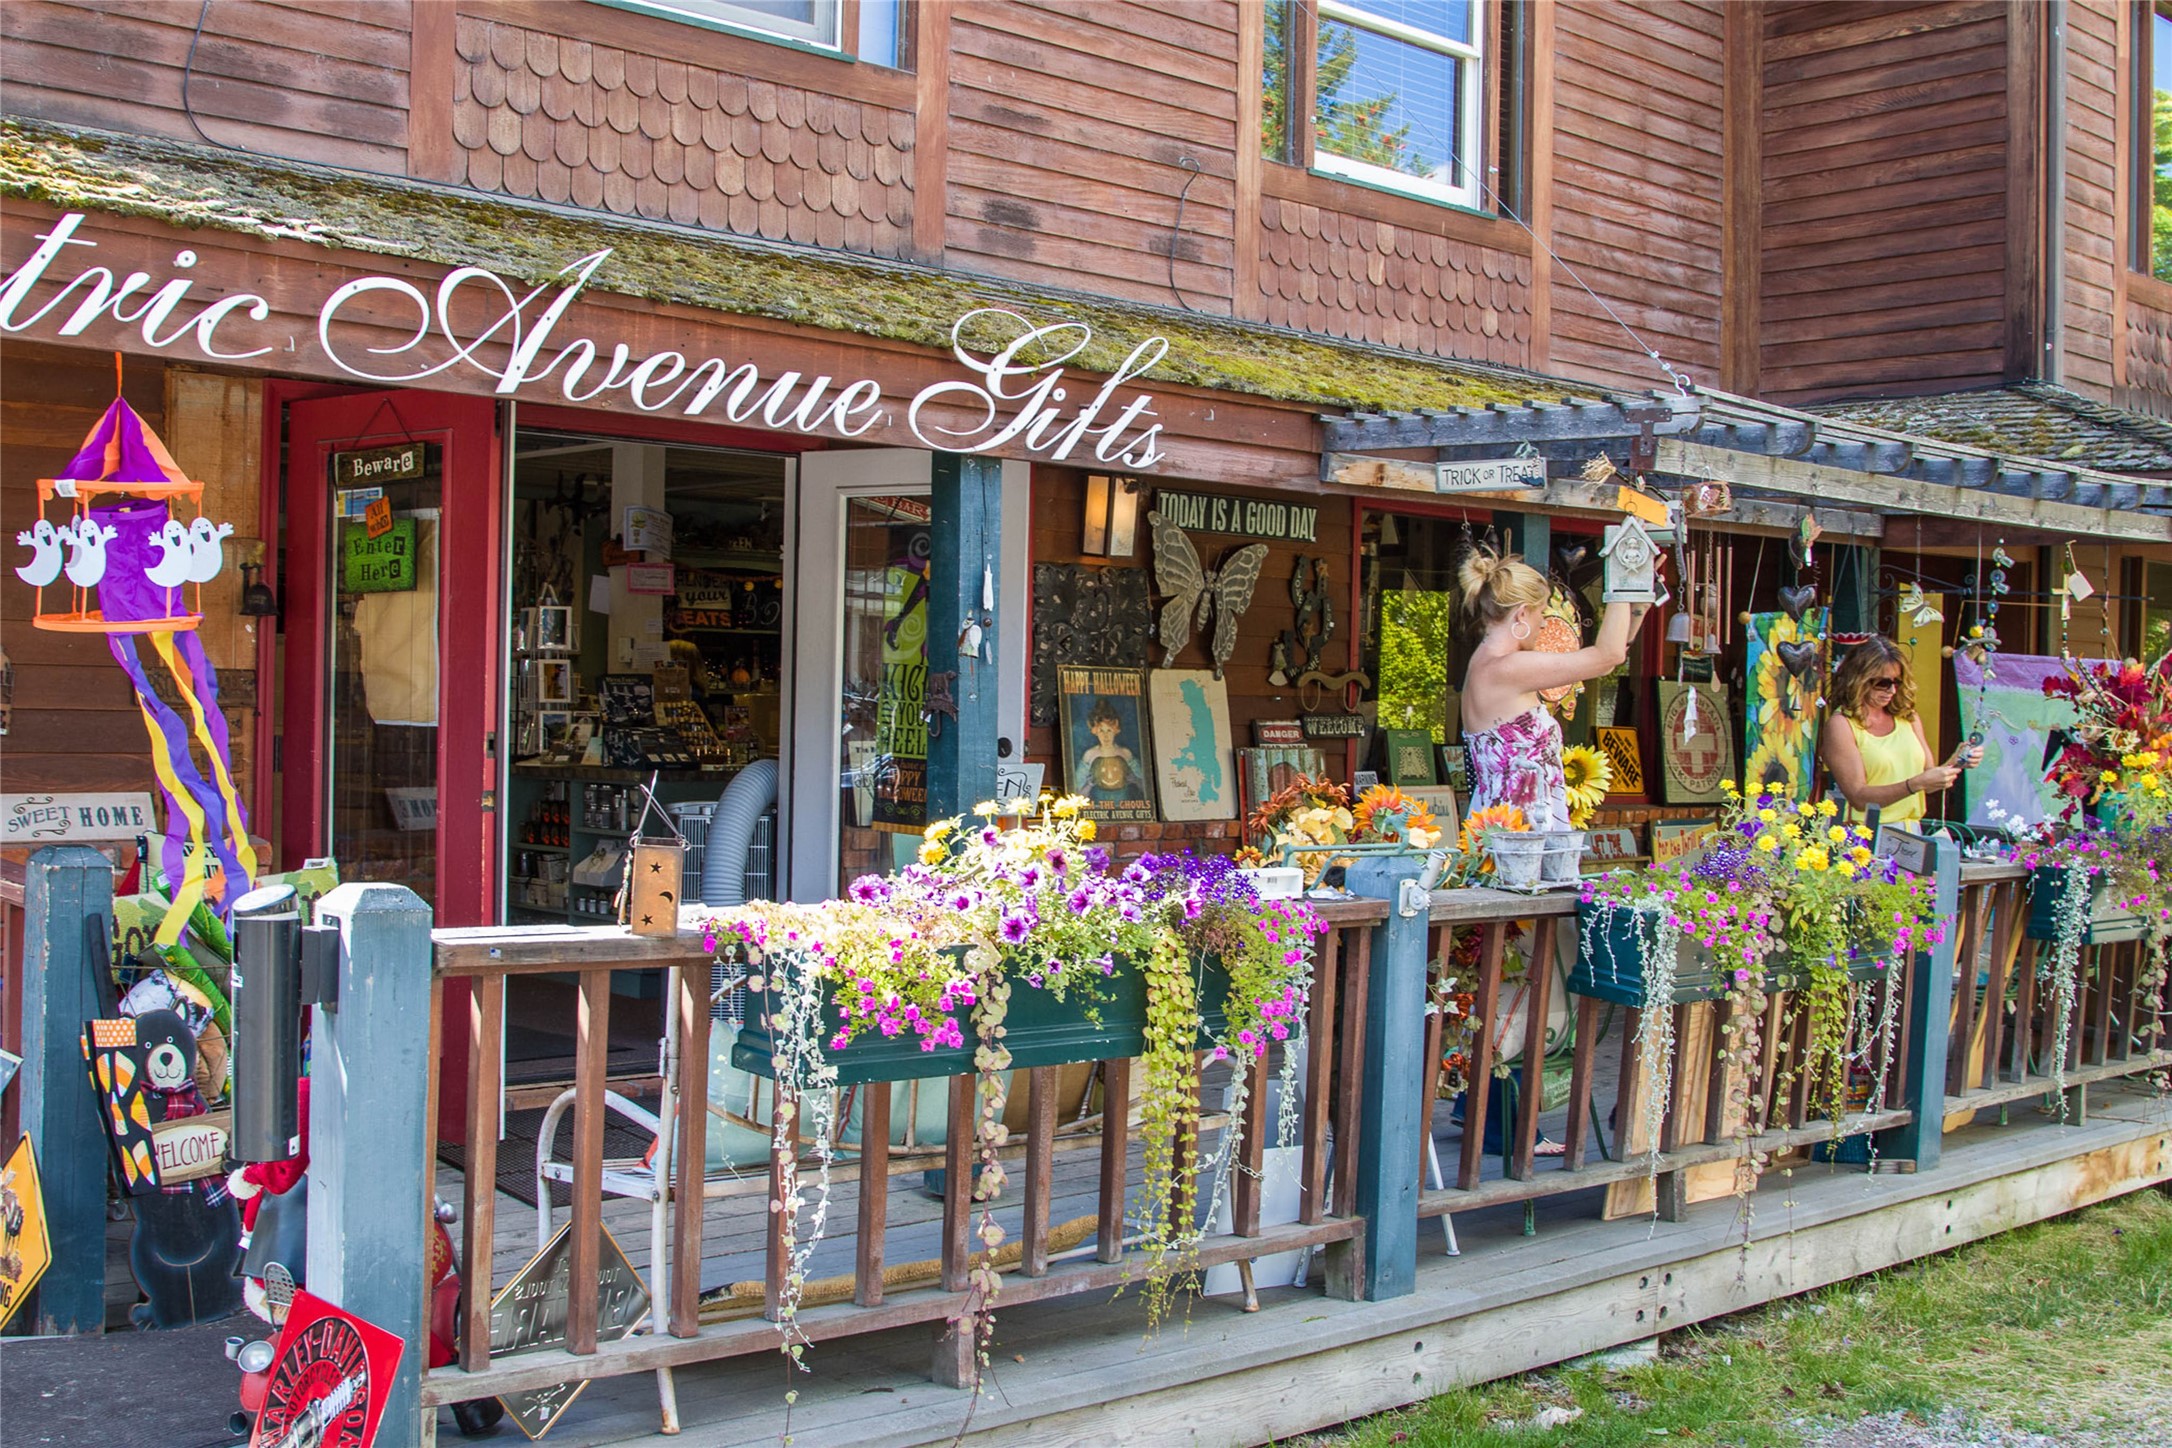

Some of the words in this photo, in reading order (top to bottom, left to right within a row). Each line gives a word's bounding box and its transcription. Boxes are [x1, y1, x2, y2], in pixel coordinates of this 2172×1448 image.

[317, 247, 884, 437] Avenue
[907, 308, 1167, 469] Gifts
[353, 451, 414, 478] Beware
[1442, 468, 1481, 486] TRICK
[1483, 469, 1495, 480] OR
[1160, 492, 1208, 530] TODAY
[1211, 498, 1227, 531] IS
[1230, 500, 1241, 533] A
[1246, 502, 1286, 537] GOOD
[1290, 506, 1317, 541] DAY
[353, 536, 405, 556] Enter
[360, 558, 401, 582] Here
[686, 591, 728, 607] your
[1063, 670, 1090, 695] HAPPY
[1092, 671, 1141, 696] HALLOWEEN
[1263, 730, 1300, 739] DANGER
[1602, 730, 1643, 789] BEWARE
[1690, 764, 1723, 788] PATROL
[1099, 801, 1115, 809] THE
[1119, 800, 1151, 809] GHOULS
[8, 806, 71, 833] SWEET
[78, 806, 144, 827] HOME
